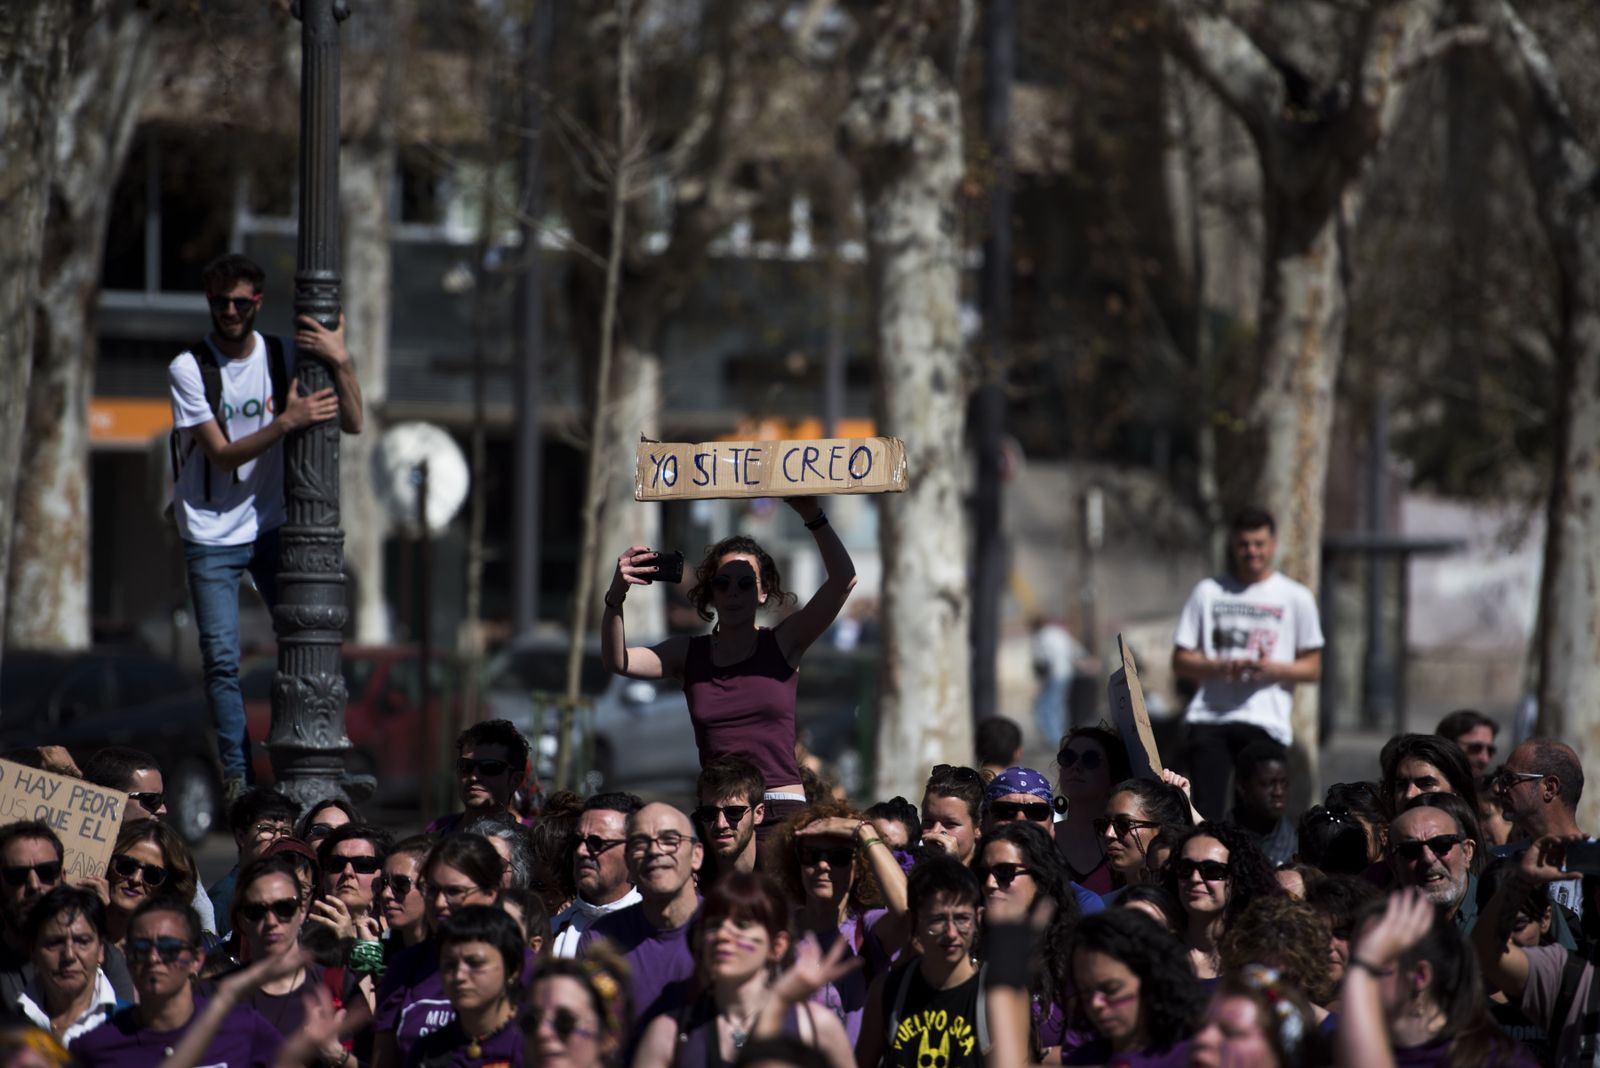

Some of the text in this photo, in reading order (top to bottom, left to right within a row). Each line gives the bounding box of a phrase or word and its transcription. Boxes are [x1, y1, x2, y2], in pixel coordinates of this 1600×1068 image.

[650, 453, 678, 488] YO
[728, 448, 761, 484] TE
[782, 446, 873, 483] CREO
[14, 769, 62, 801] HAY
[68, 785, 119, 821] PEOR
[34, 804, 72, 831] QUE
[79, 817, 106, 842] EL
